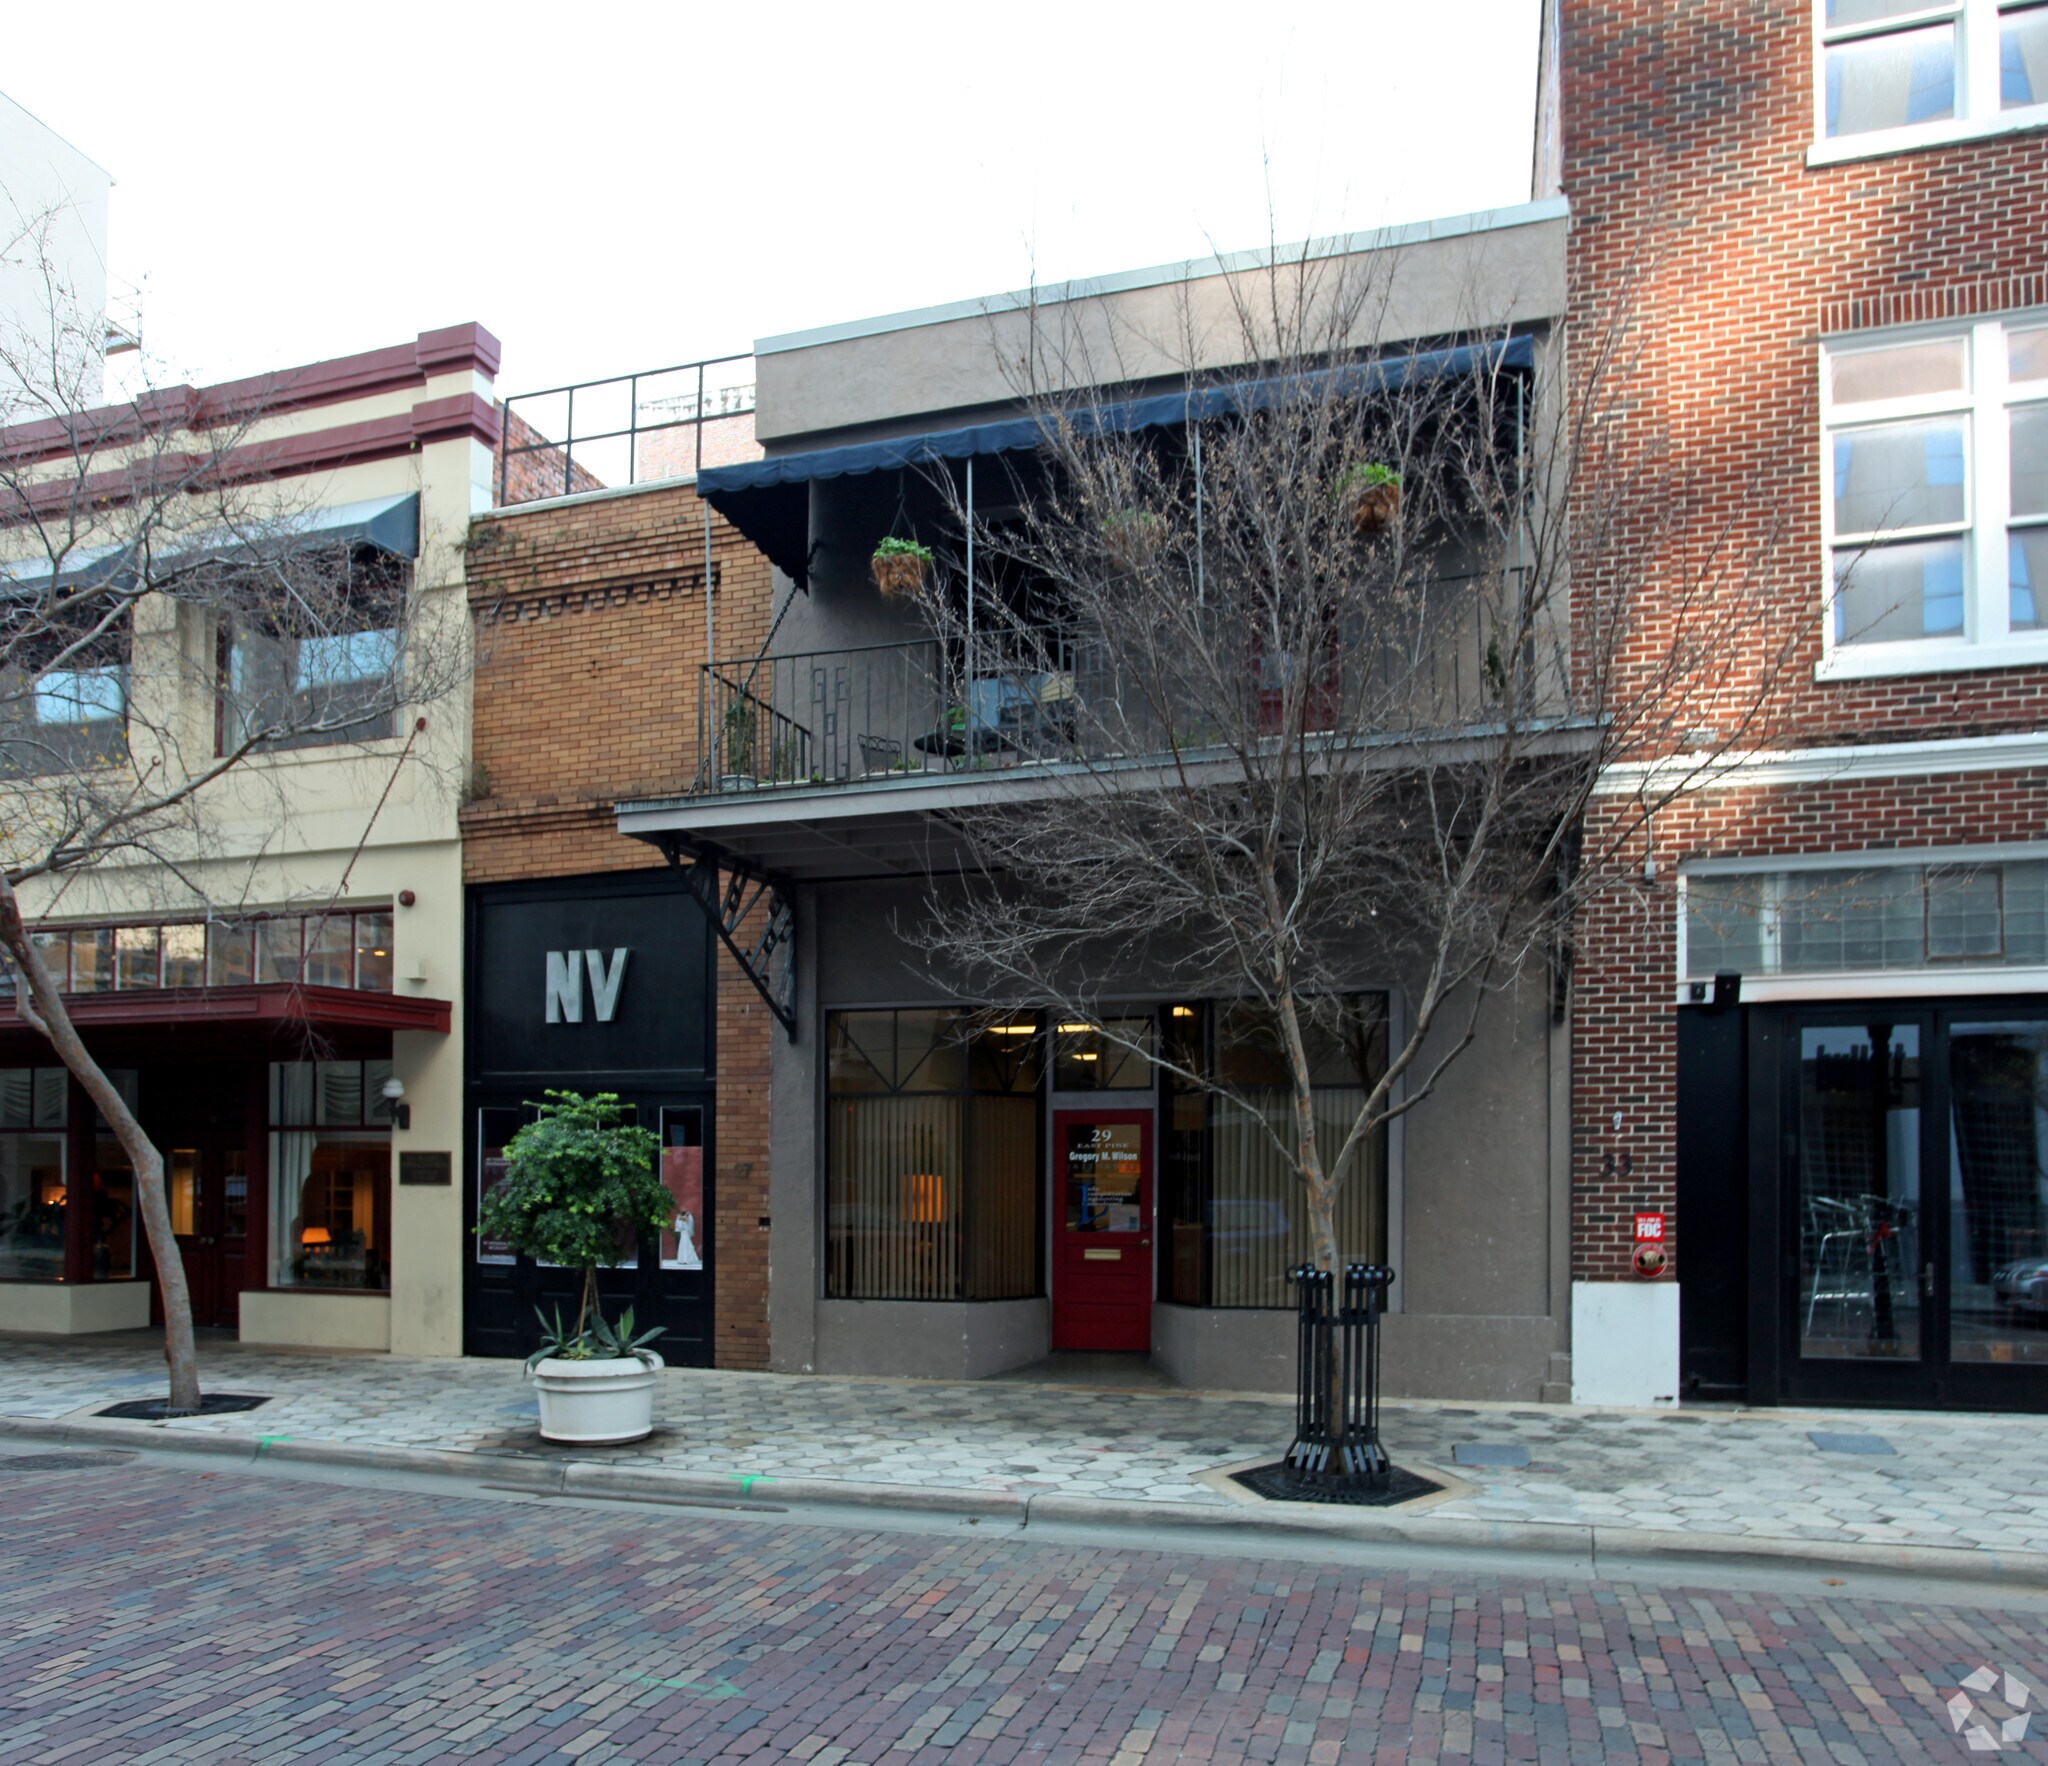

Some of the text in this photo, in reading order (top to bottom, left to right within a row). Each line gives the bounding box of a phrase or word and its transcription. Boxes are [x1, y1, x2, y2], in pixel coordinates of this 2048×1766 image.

[545, 947, 630, 1023] NV
[1090, 1129, 1112, 1142] 29
[1069, 1151, 1137, 1162] Gregory M. Wilson
[1600, 1153, 1632, 1177] 33
[1637, 1223, 1662, 1239] FDC
